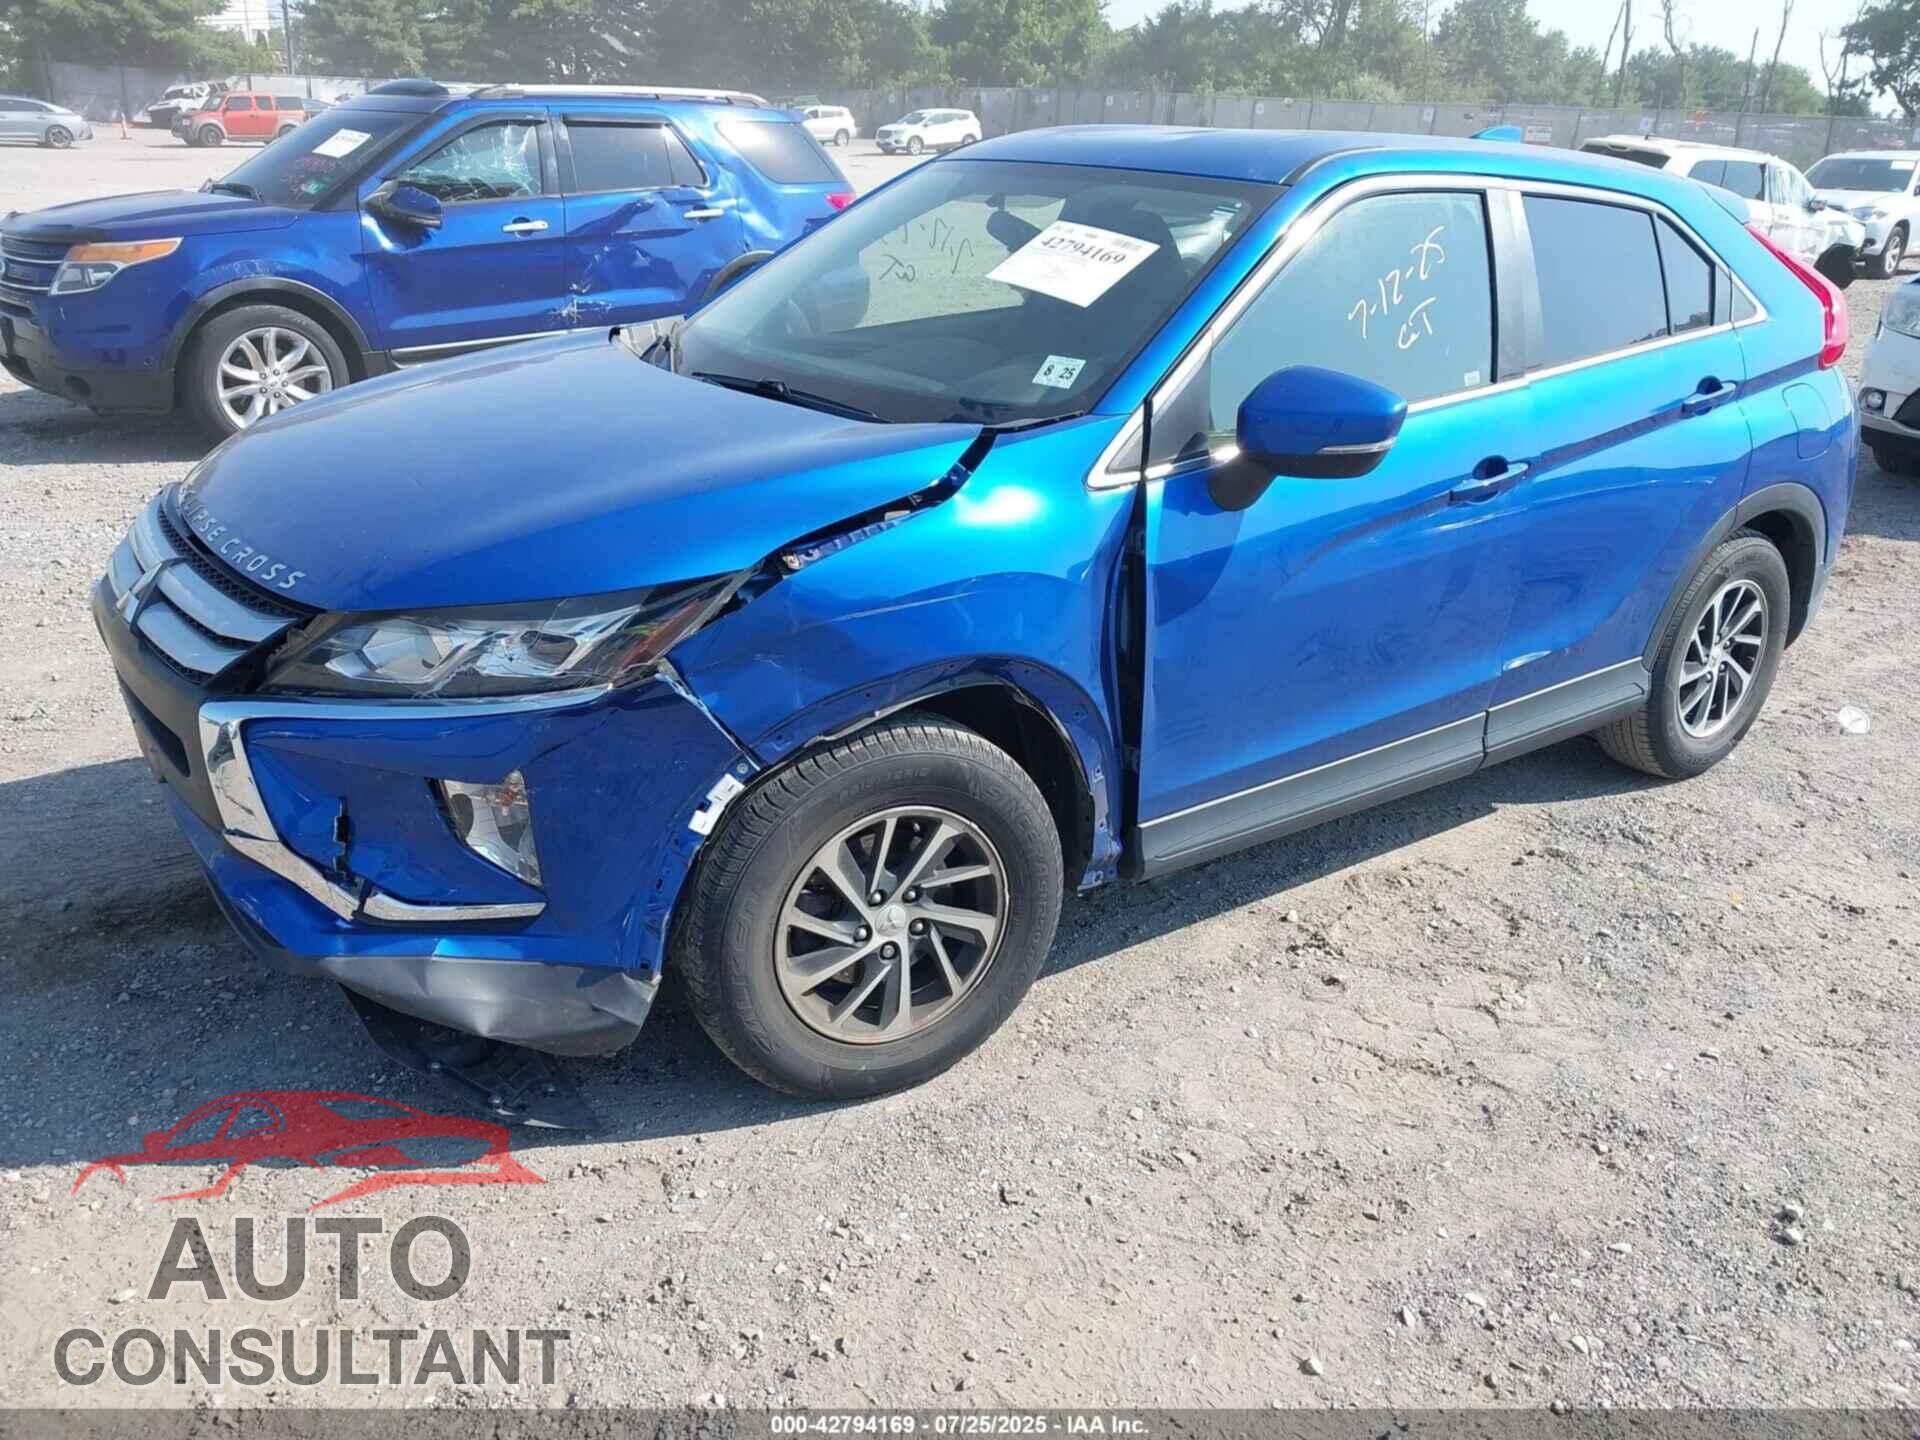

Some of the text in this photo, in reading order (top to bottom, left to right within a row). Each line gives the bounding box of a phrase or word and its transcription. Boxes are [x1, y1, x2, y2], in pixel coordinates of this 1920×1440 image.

[1041, 236, 1127, 265] 42794169
[1347, 225, 1446, 340] 7-12-25
[1043, 364, 1076, 380] 8 25
[219, 537, 306, 589] CROSS
